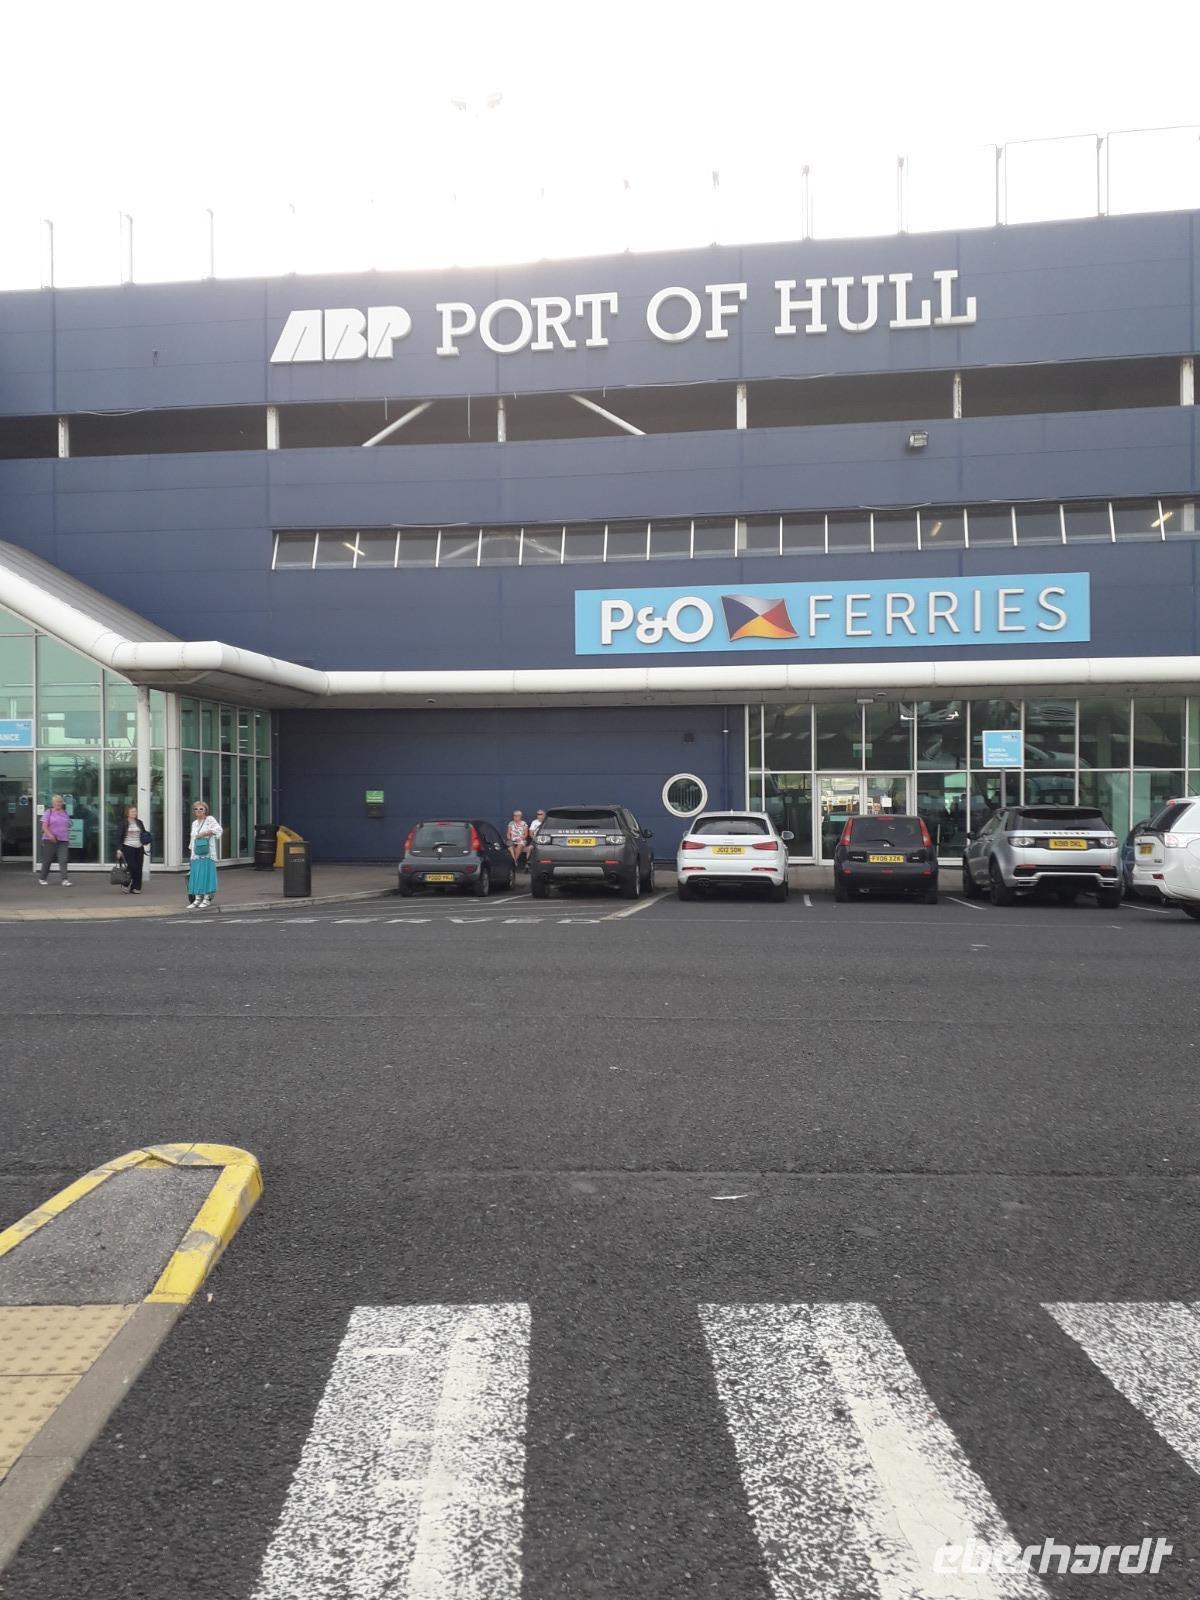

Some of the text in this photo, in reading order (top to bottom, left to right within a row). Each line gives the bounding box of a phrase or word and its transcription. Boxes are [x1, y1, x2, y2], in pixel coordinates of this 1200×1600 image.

[269, 269, 978, 363] ABP PORT OF HULL
[601, 586, 1069, 645] P&O FERRIES
